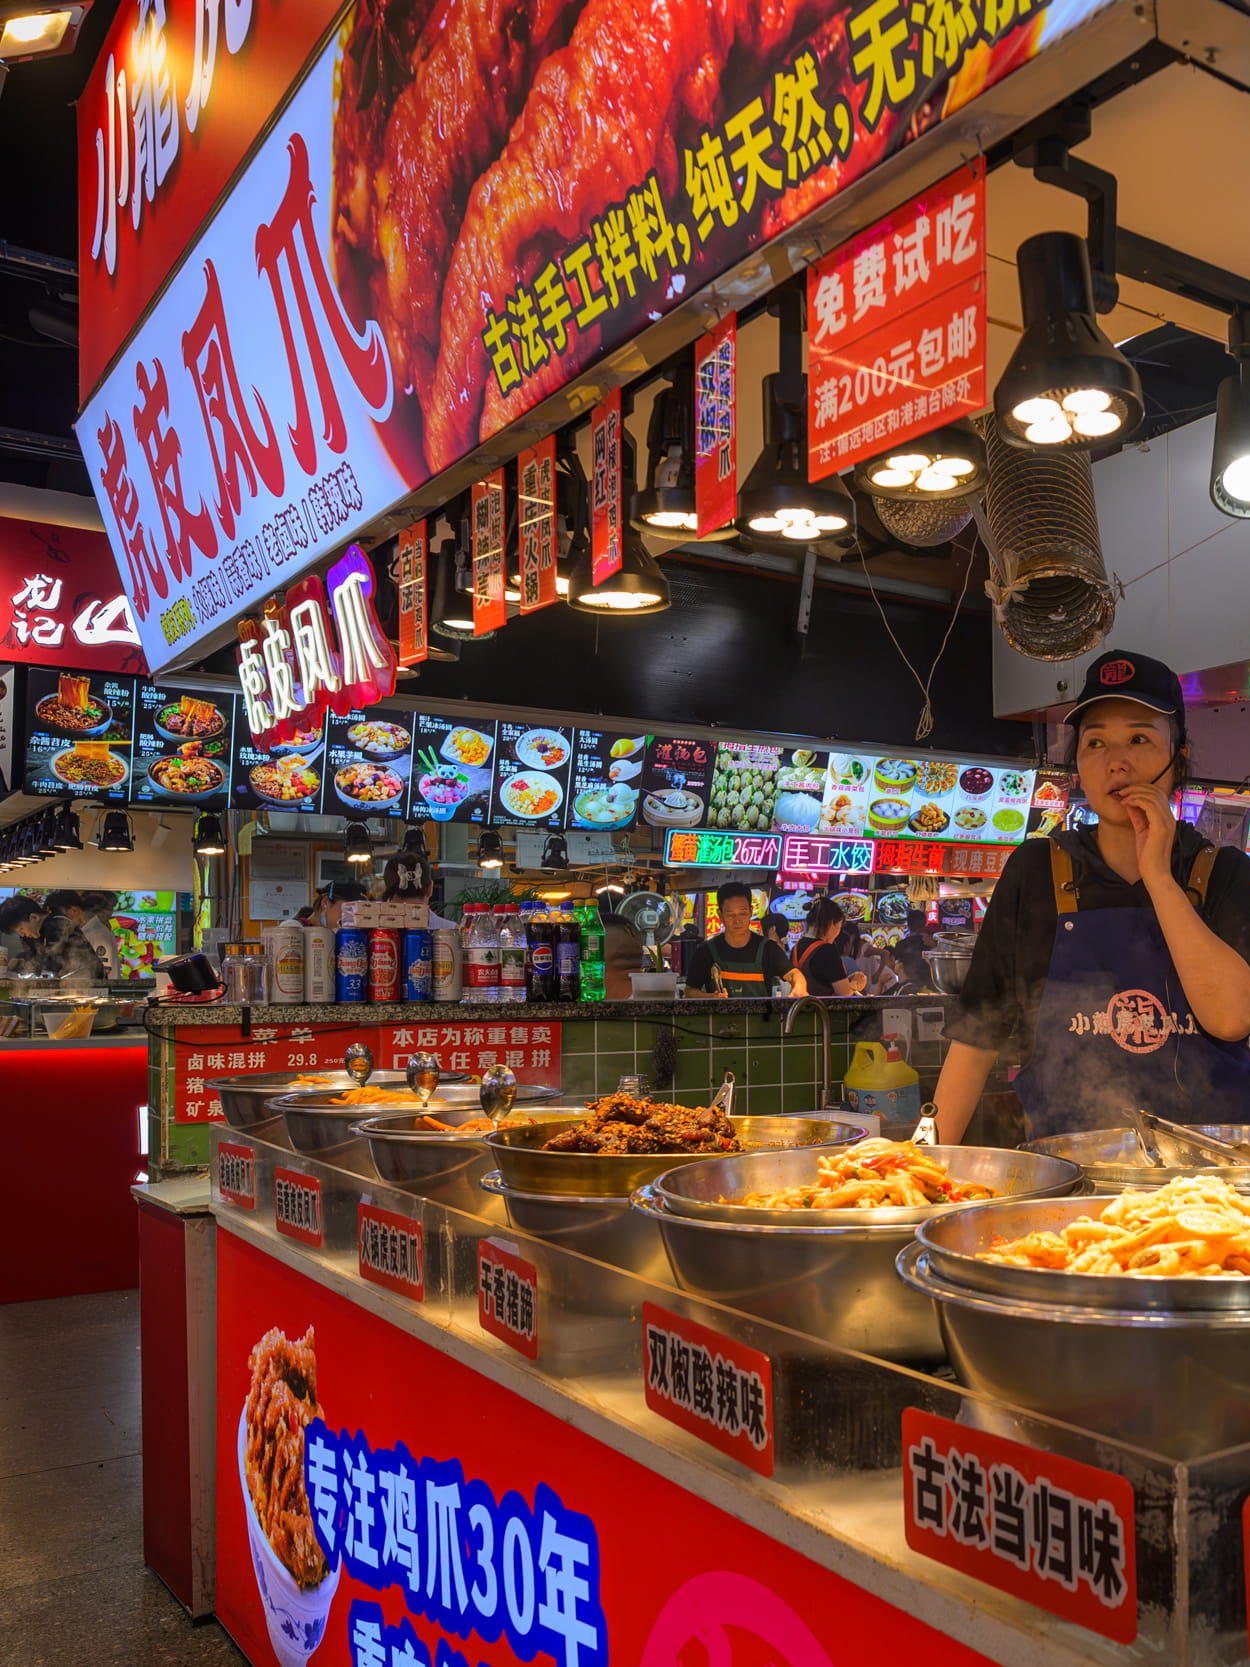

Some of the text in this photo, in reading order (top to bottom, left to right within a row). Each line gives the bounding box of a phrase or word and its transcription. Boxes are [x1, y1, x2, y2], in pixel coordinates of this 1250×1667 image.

[813, 192, 977, 344] 免费试吃
[97, 133, 386, 622] 虎皮凤爪
[814, 306, 977, 428] 满200元包邮
[593, 419, 607, 513] 网红
[522, 457, 539, 606] 重庆火锅
[539, 456, 552, 572] 虎皮凤爪
[12, 574, 64, 646] 龙记
[401, 543, 413, 614] 古法
[238, 571, 389, 735] 虎皮凤爪
[787, 840, 871, 872] 手工水饺
[877, 845, 946, 872] 拇指生煎
[187, 1051, 266, 1071] 卤味混拼
[287, 1053, 317, 1067] 29.8
[252, 1028, 315, 1045] 菜单
[392, 1026, 552, 1047] 本店为称重售卖
[361, 1217, 421, 1285] 火锅虎皮凤爪
[480, 1258, 536, 1341] 干香猪蹄
[648, 1328, 767, 1446] 双椒酸辣味
[308, 1437, 597, 1667] 专注鸡爪30年
[911, 1443, 1123, 1601] 古法当归味
